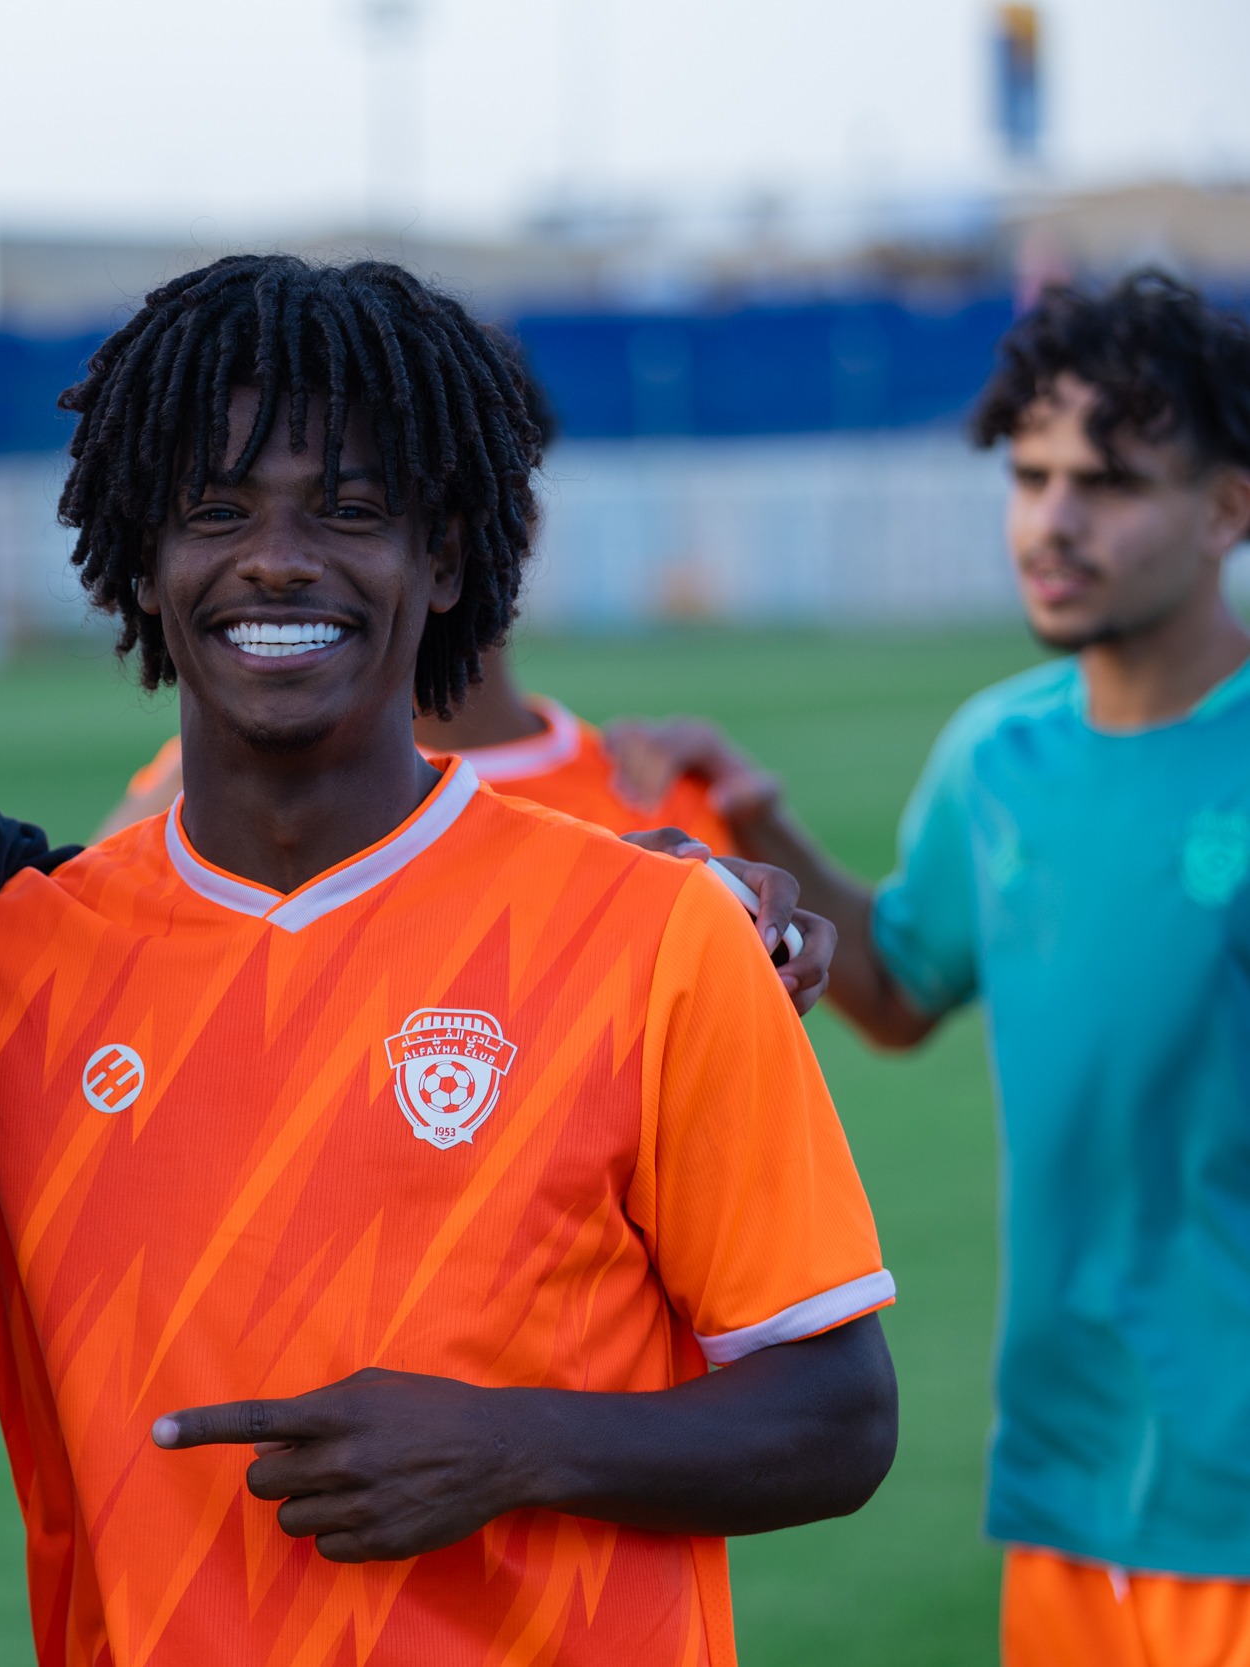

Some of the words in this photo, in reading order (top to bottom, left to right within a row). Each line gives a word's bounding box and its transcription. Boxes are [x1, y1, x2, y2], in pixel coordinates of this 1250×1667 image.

[403, 1045, 459, 1061] ALFAYHA
[464, 1047, 496, 1065] CLUB
[434, 1126, 456, 1137] 1953
